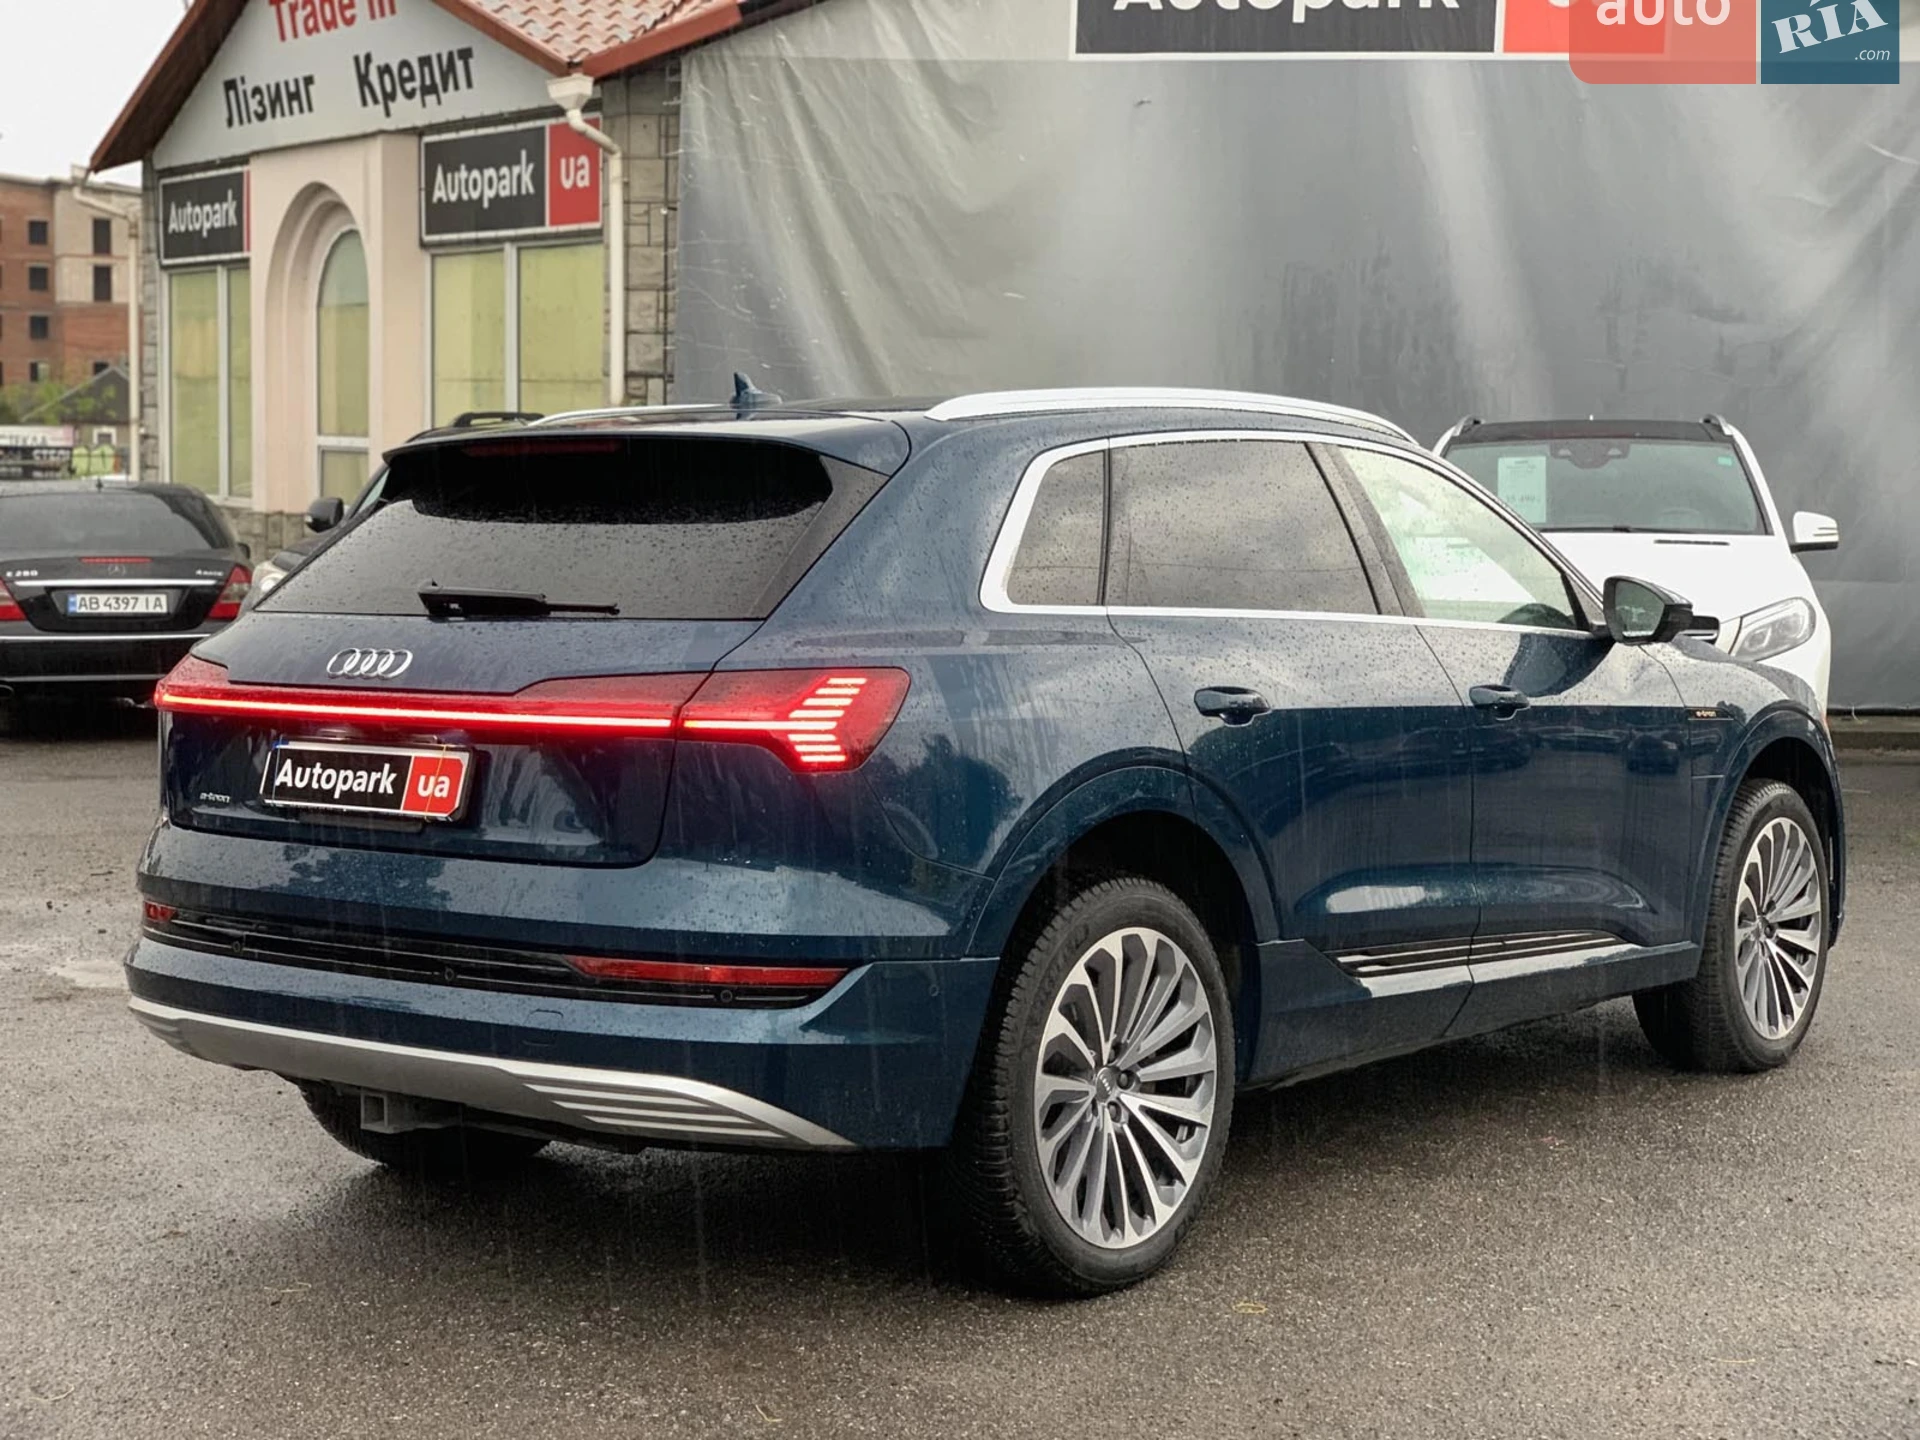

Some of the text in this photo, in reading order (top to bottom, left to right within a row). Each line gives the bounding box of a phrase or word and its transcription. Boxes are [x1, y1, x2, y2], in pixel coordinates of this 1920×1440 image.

[268, 0, 357, 42] Trade
[223, 47, 474, 129] Лізинг Кредит
[432, 149, 590, 208] Autopark ua
[168, 189, 238, 239] Autopark
[78, 597, 101, 611] AB
[103, 596, 138, 611] 4397
[275, 758, 451, 799] Autopark ua
